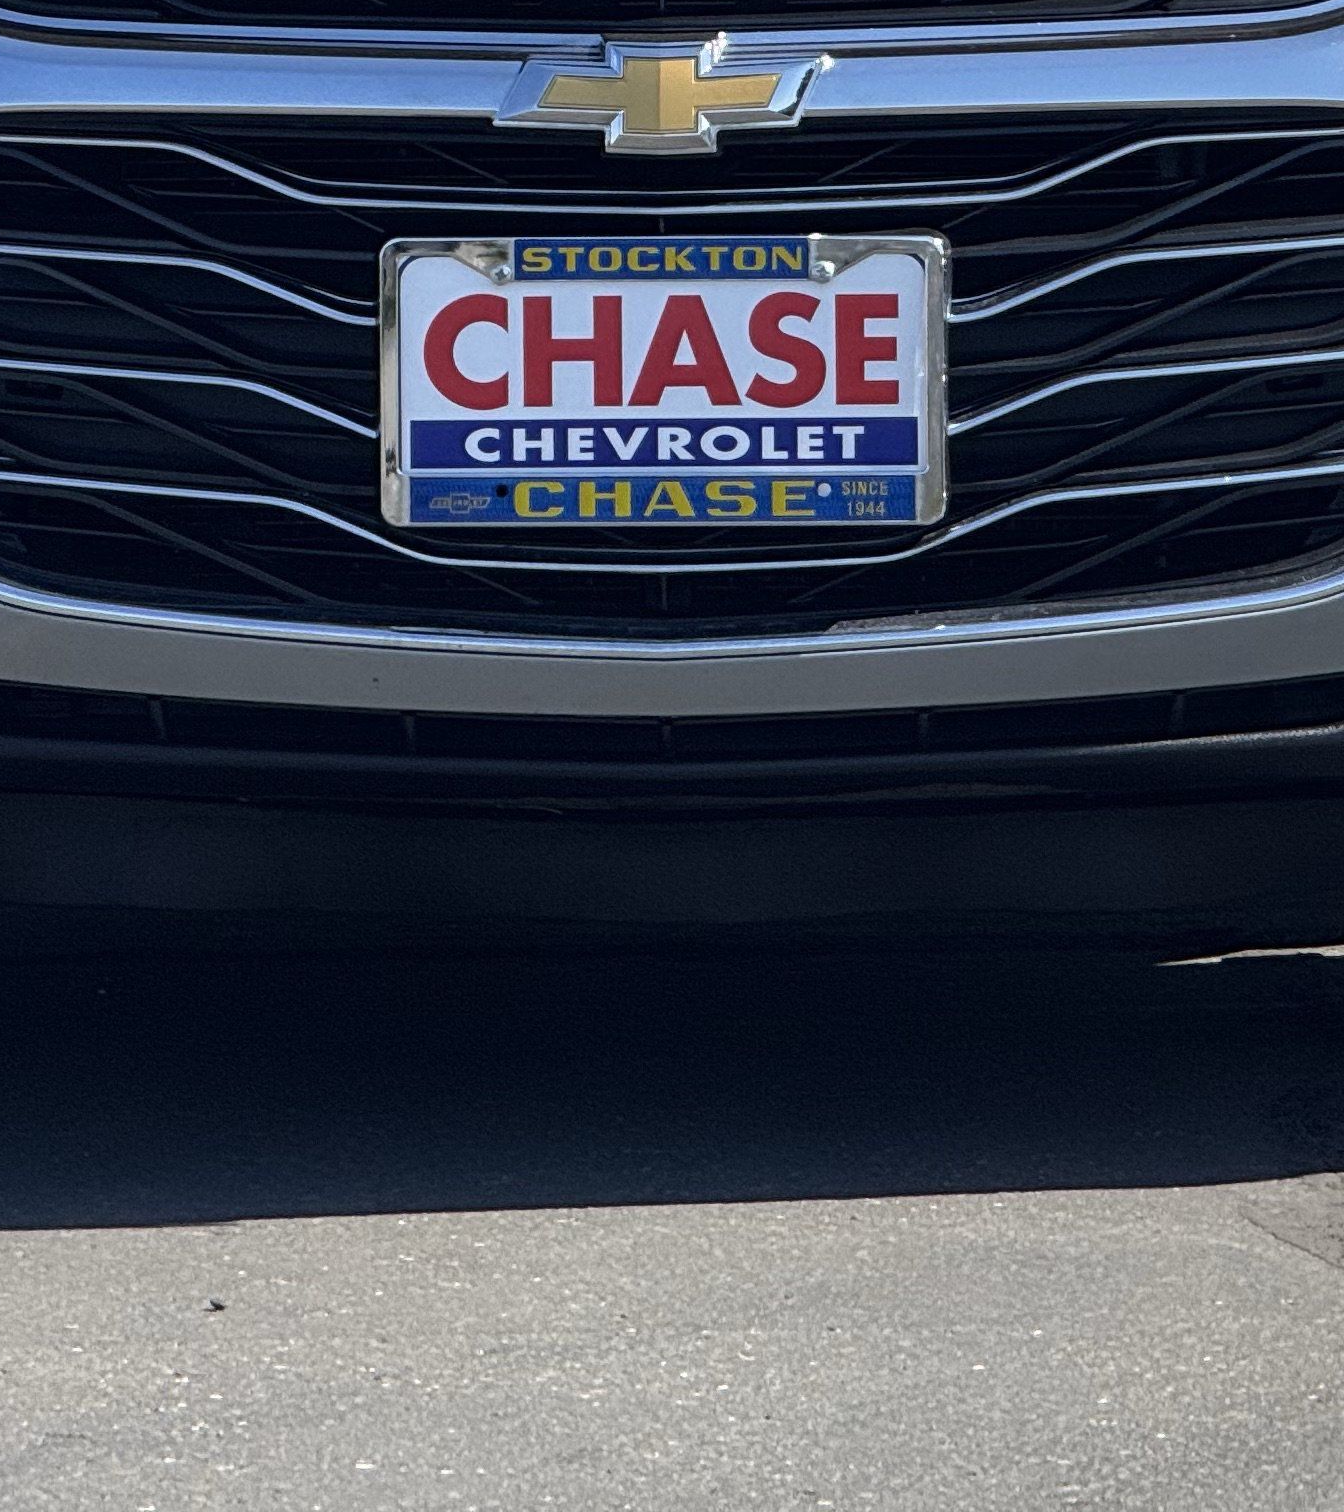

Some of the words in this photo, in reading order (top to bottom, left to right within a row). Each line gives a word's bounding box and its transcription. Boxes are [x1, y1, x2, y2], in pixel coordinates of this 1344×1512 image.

[522, 247, 802, 272] STOCKTON
[424, 291, 899, 410] CHASE
[465, 426, 864, 462] CHEVROLET
[514, 480, 816, 518] CHASE
[841, 481, 888, 495] SINCE
[847, 501, 885, 517] 1944
